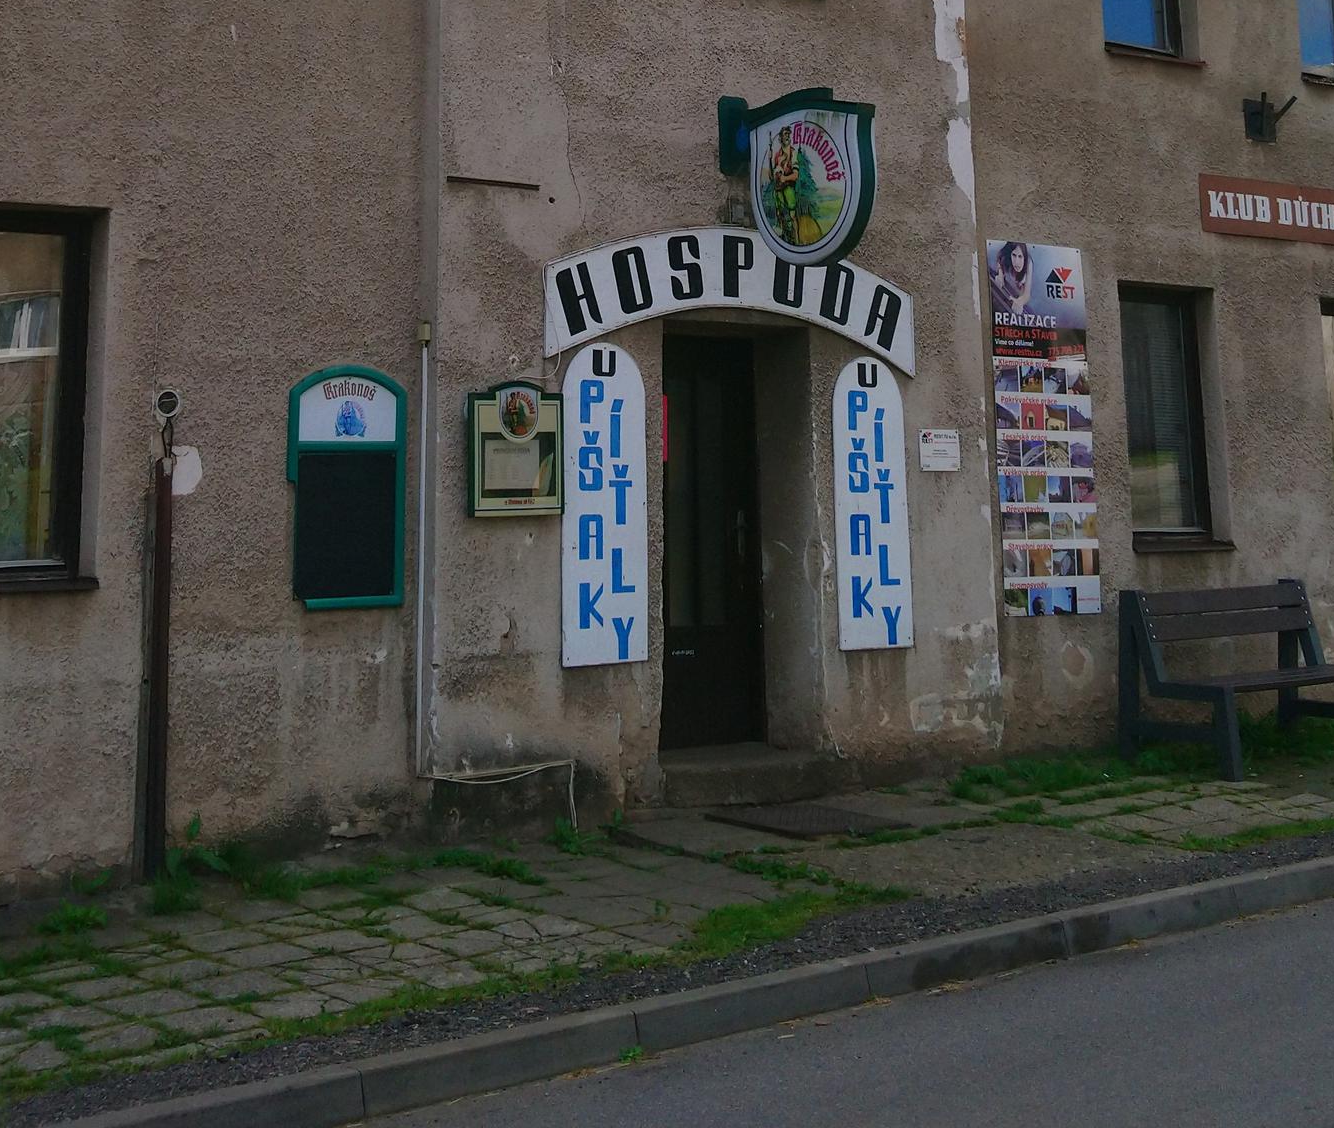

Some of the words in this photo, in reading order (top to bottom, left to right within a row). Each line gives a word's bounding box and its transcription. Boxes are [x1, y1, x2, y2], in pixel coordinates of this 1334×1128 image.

[1207, 190, 1271, 223] KLUB
[556, 235, 902, 352] HOSPODA
[1046, 284, 1075, 300] REST
[994, 312, 1057, 329] REALIZACE
[591, 349, 616, 377] U
[857, 363, 878, 389] U
[323, 380, 377, 401] Krakonoš
